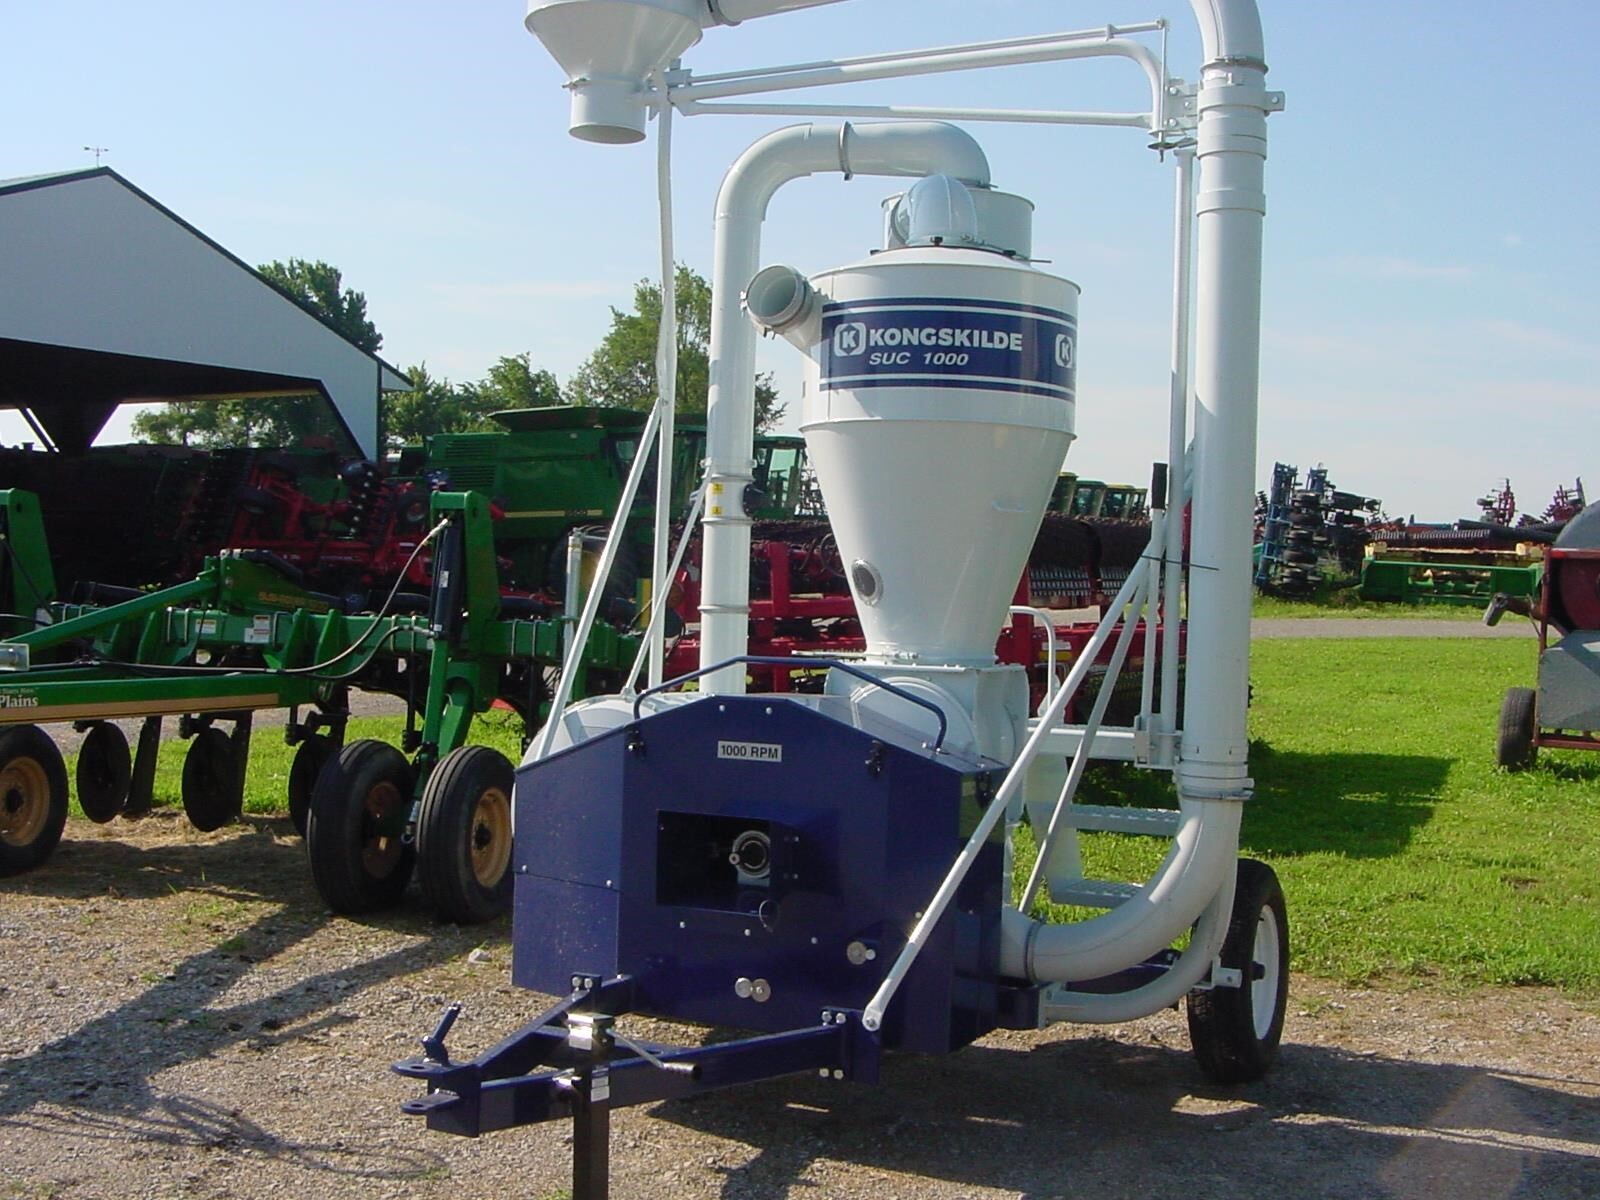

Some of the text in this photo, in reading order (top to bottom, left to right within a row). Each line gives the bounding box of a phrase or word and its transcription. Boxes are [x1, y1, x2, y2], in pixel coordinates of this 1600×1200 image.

[869, 327, 1023, 351] KONGSKILDE
[869, 352, 969, 366] SUC 1000
[0, 694, 39, 708] Plains
[721, 744, 778, 759] 1000 RPM
